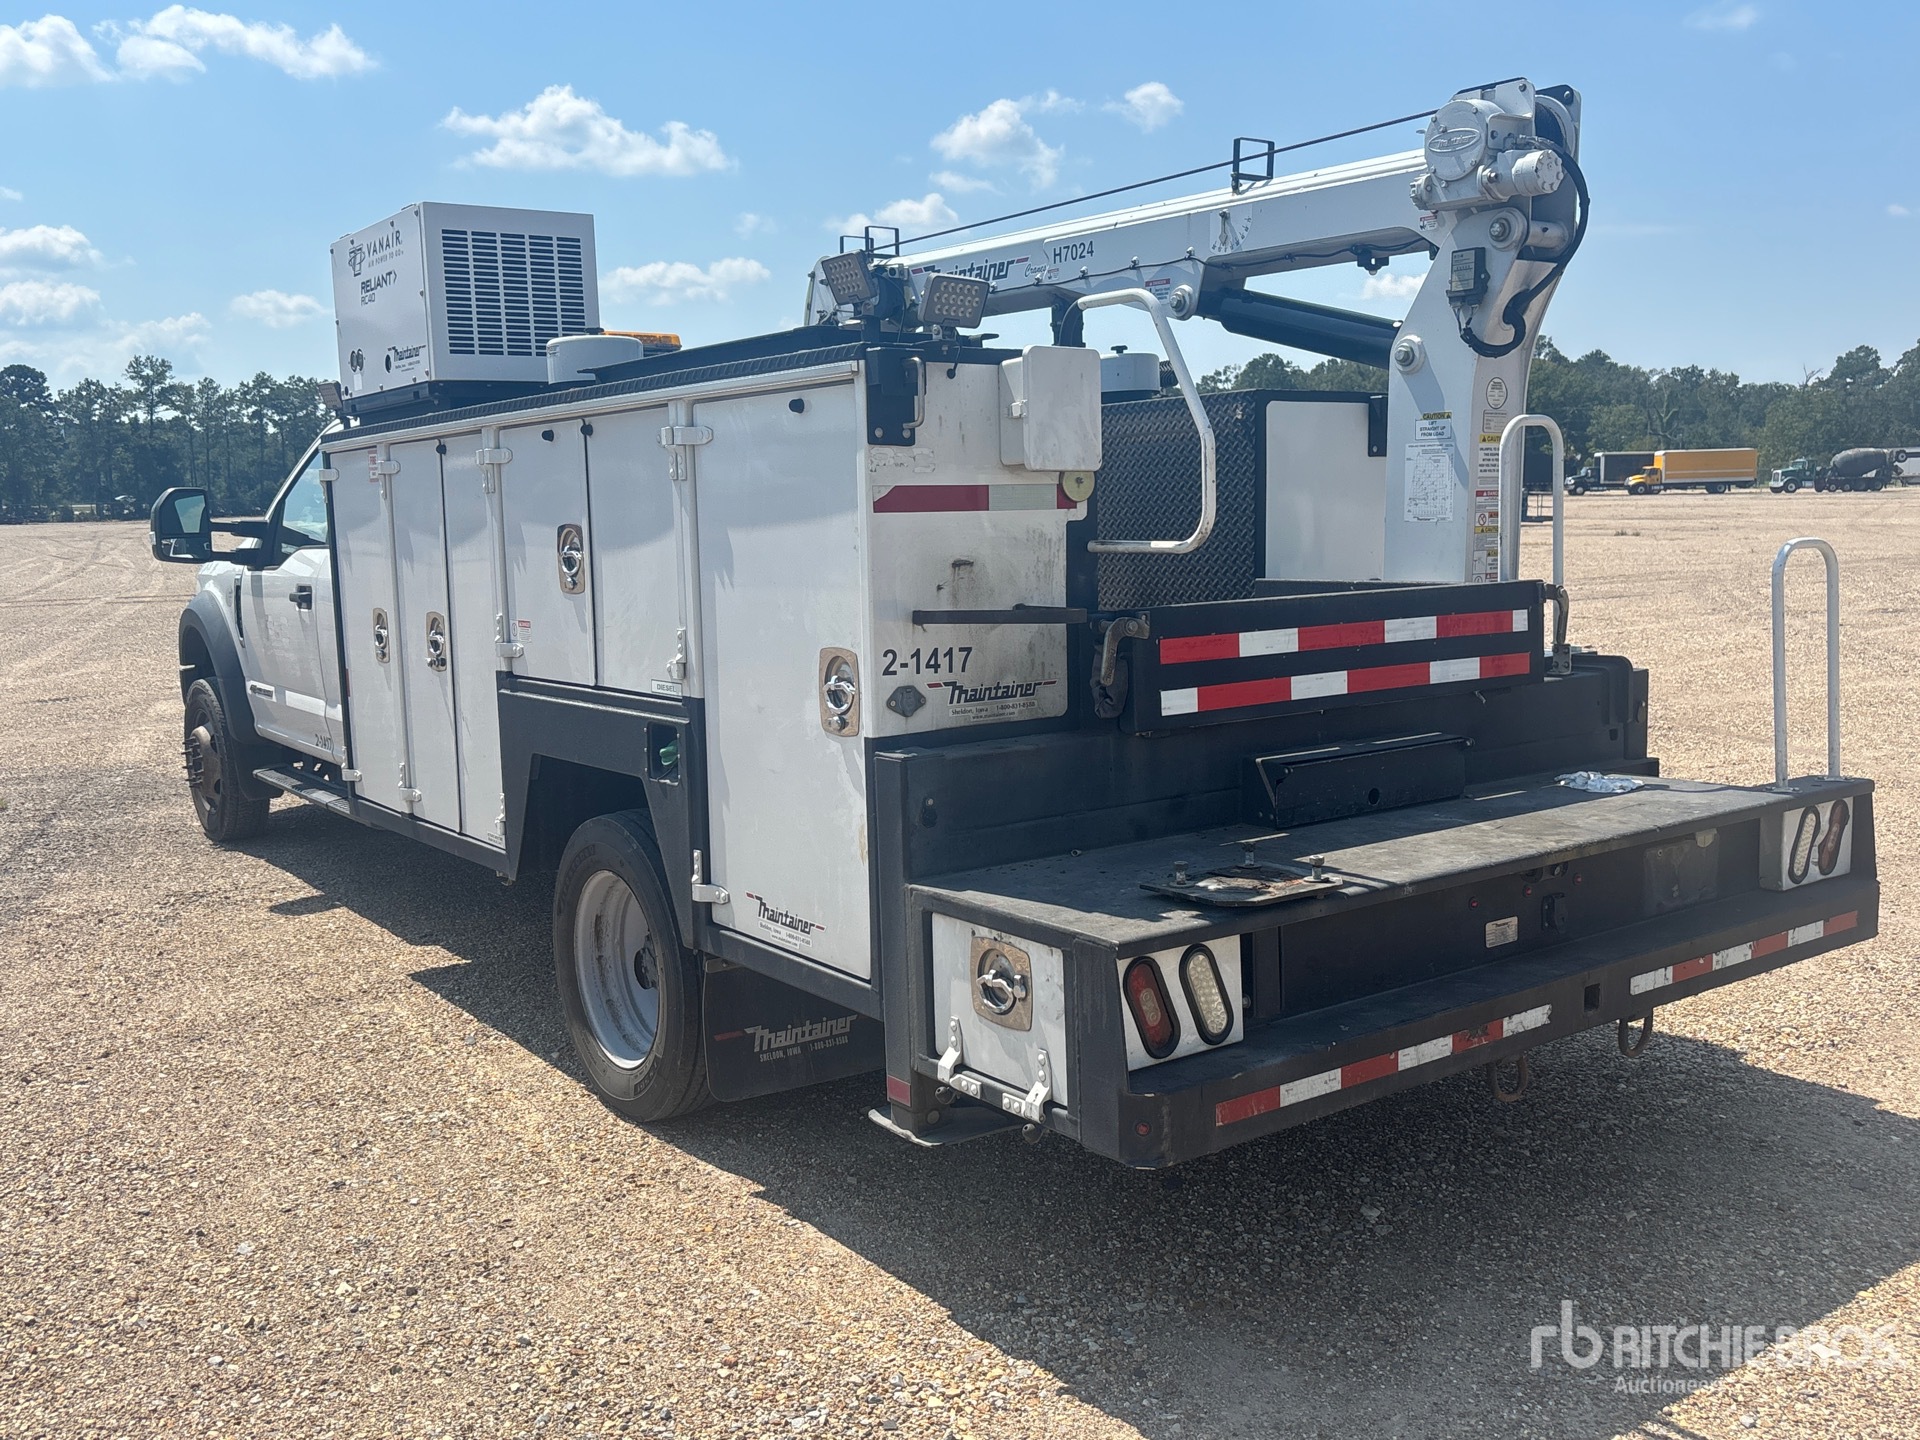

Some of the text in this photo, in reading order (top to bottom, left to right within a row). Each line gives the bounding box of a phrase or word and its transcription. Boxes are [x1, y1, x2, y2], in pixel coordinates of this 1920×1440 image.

[366, 230, 401, 257] VANAIR
[1053, 240, 1095, 264] H7024
[923, 259, 1015, 282] intainer
[361, 271, 392, 295] RELIANT
[361, 292, 375, 306] RC40
[881, 646, 973, 676] 2-1417
[656, 683, 677, 693] DIESEL
[943, 681, 1043, 705] Maintainer
[754, 894, 815, 935] Maintainer
[744, 1014, 858, 1053] Maintainer
[787, 1045, 802, 1057] IOWA
